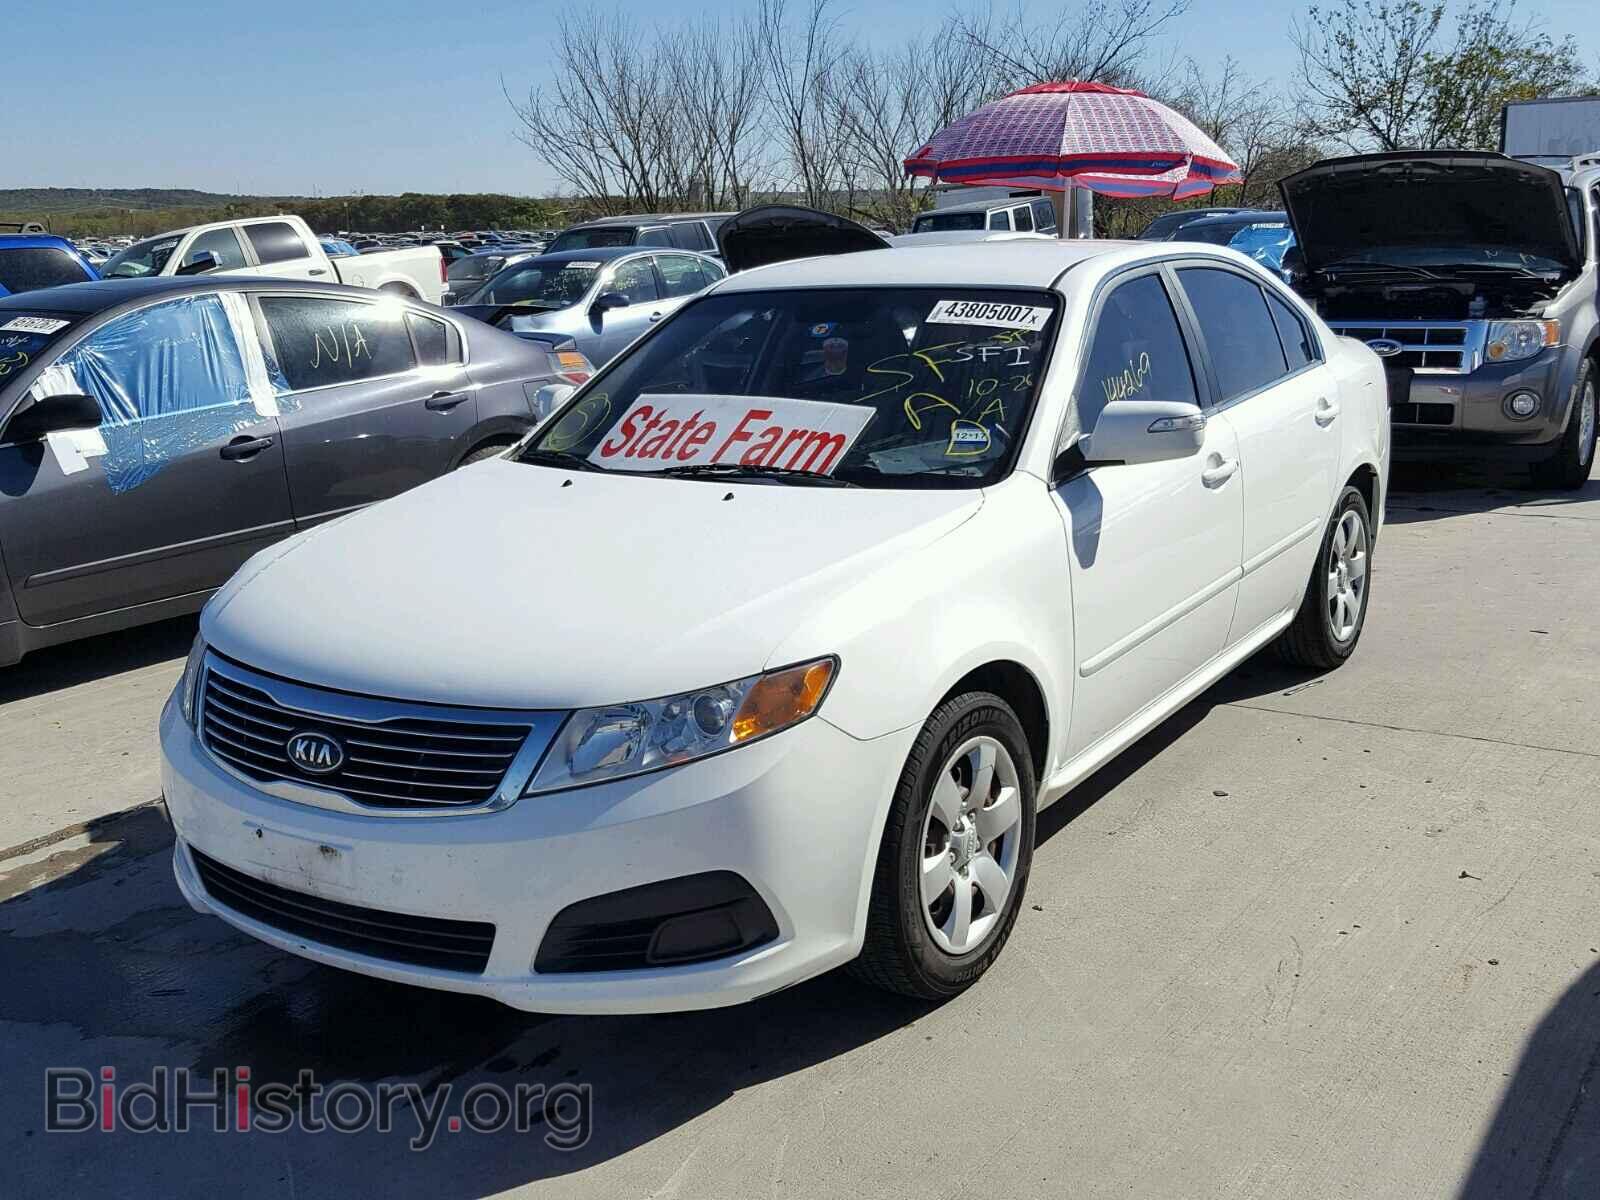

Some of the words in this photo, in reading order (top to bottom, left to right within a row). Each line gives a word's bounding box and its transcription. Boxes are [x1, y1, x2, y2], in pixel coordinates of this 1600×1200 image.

[310, 322, 372, 368] N/A
[601, 405, 716, 460] State
[711, 409, 846, 476] Farm
[295, 738, 332, 765] KIA
